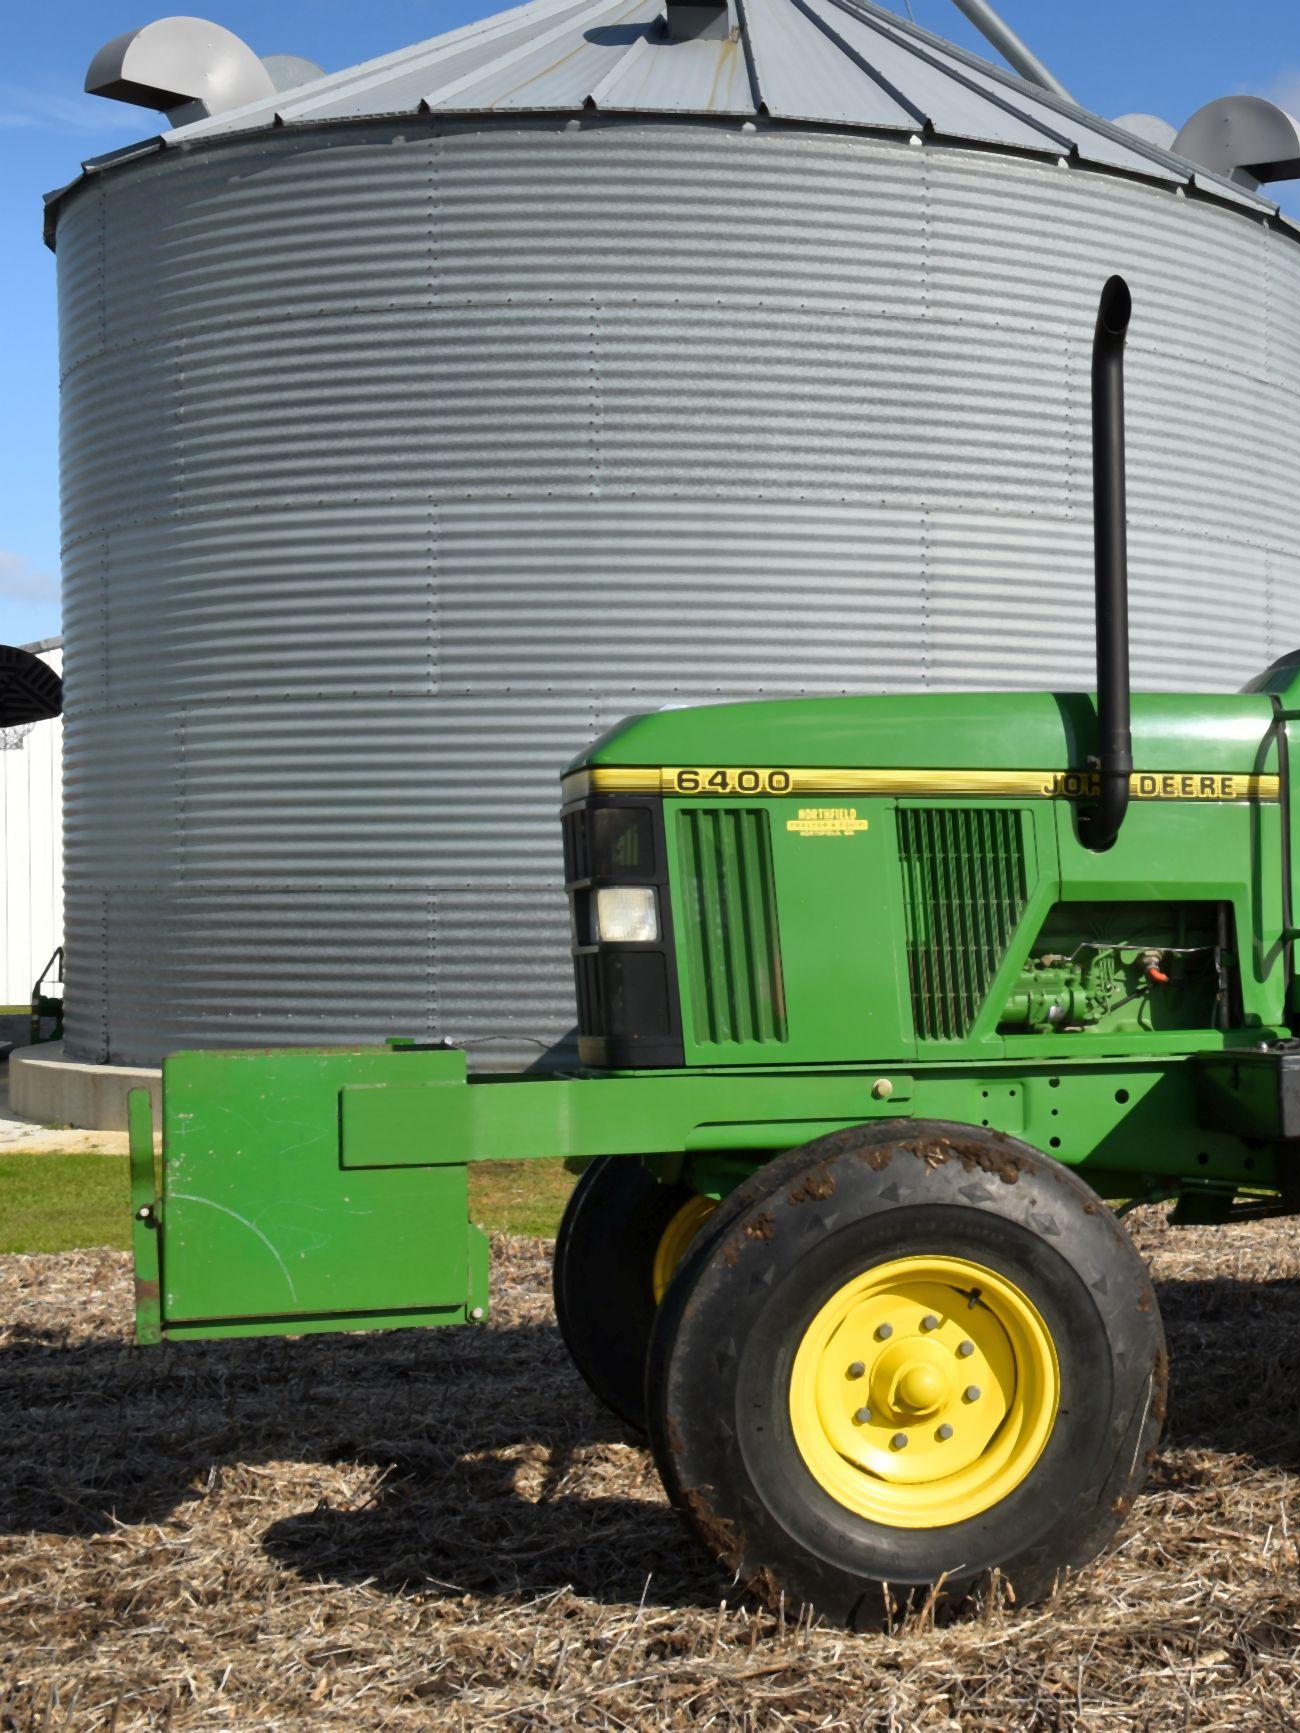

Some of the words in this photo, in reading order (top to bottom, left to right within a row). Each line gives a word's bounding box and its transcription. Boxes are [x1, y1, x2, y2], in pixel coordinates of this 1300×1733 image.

[676, 770, 791, 792] 6400
[1043, 774, 1101, 796] JOH
[1139, 774, 1234, 796] DEERE
